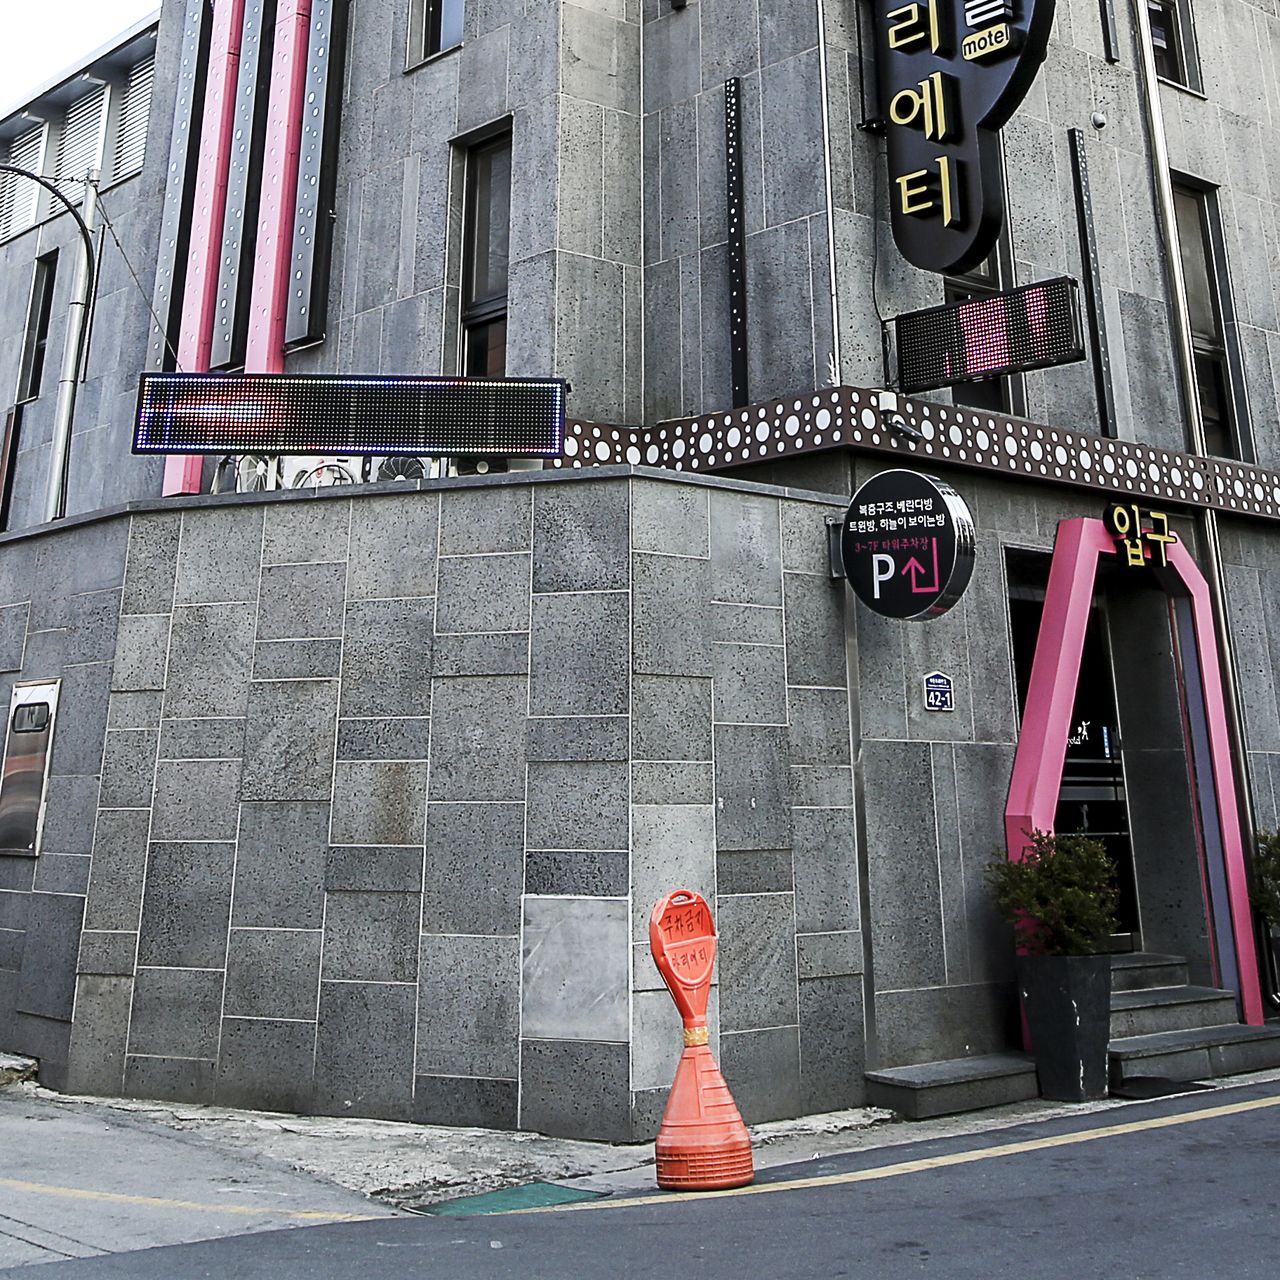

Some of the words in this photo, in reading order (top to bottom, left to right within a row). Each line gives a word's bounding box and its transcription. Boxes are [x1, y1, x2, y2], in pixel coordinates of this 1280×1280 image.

[963, 25, 1009, 57] motel
[1113, 504, 1176, 567] 입구
[872, 554, 895, 599] P
[928, 691, 951, 706] 42-1
